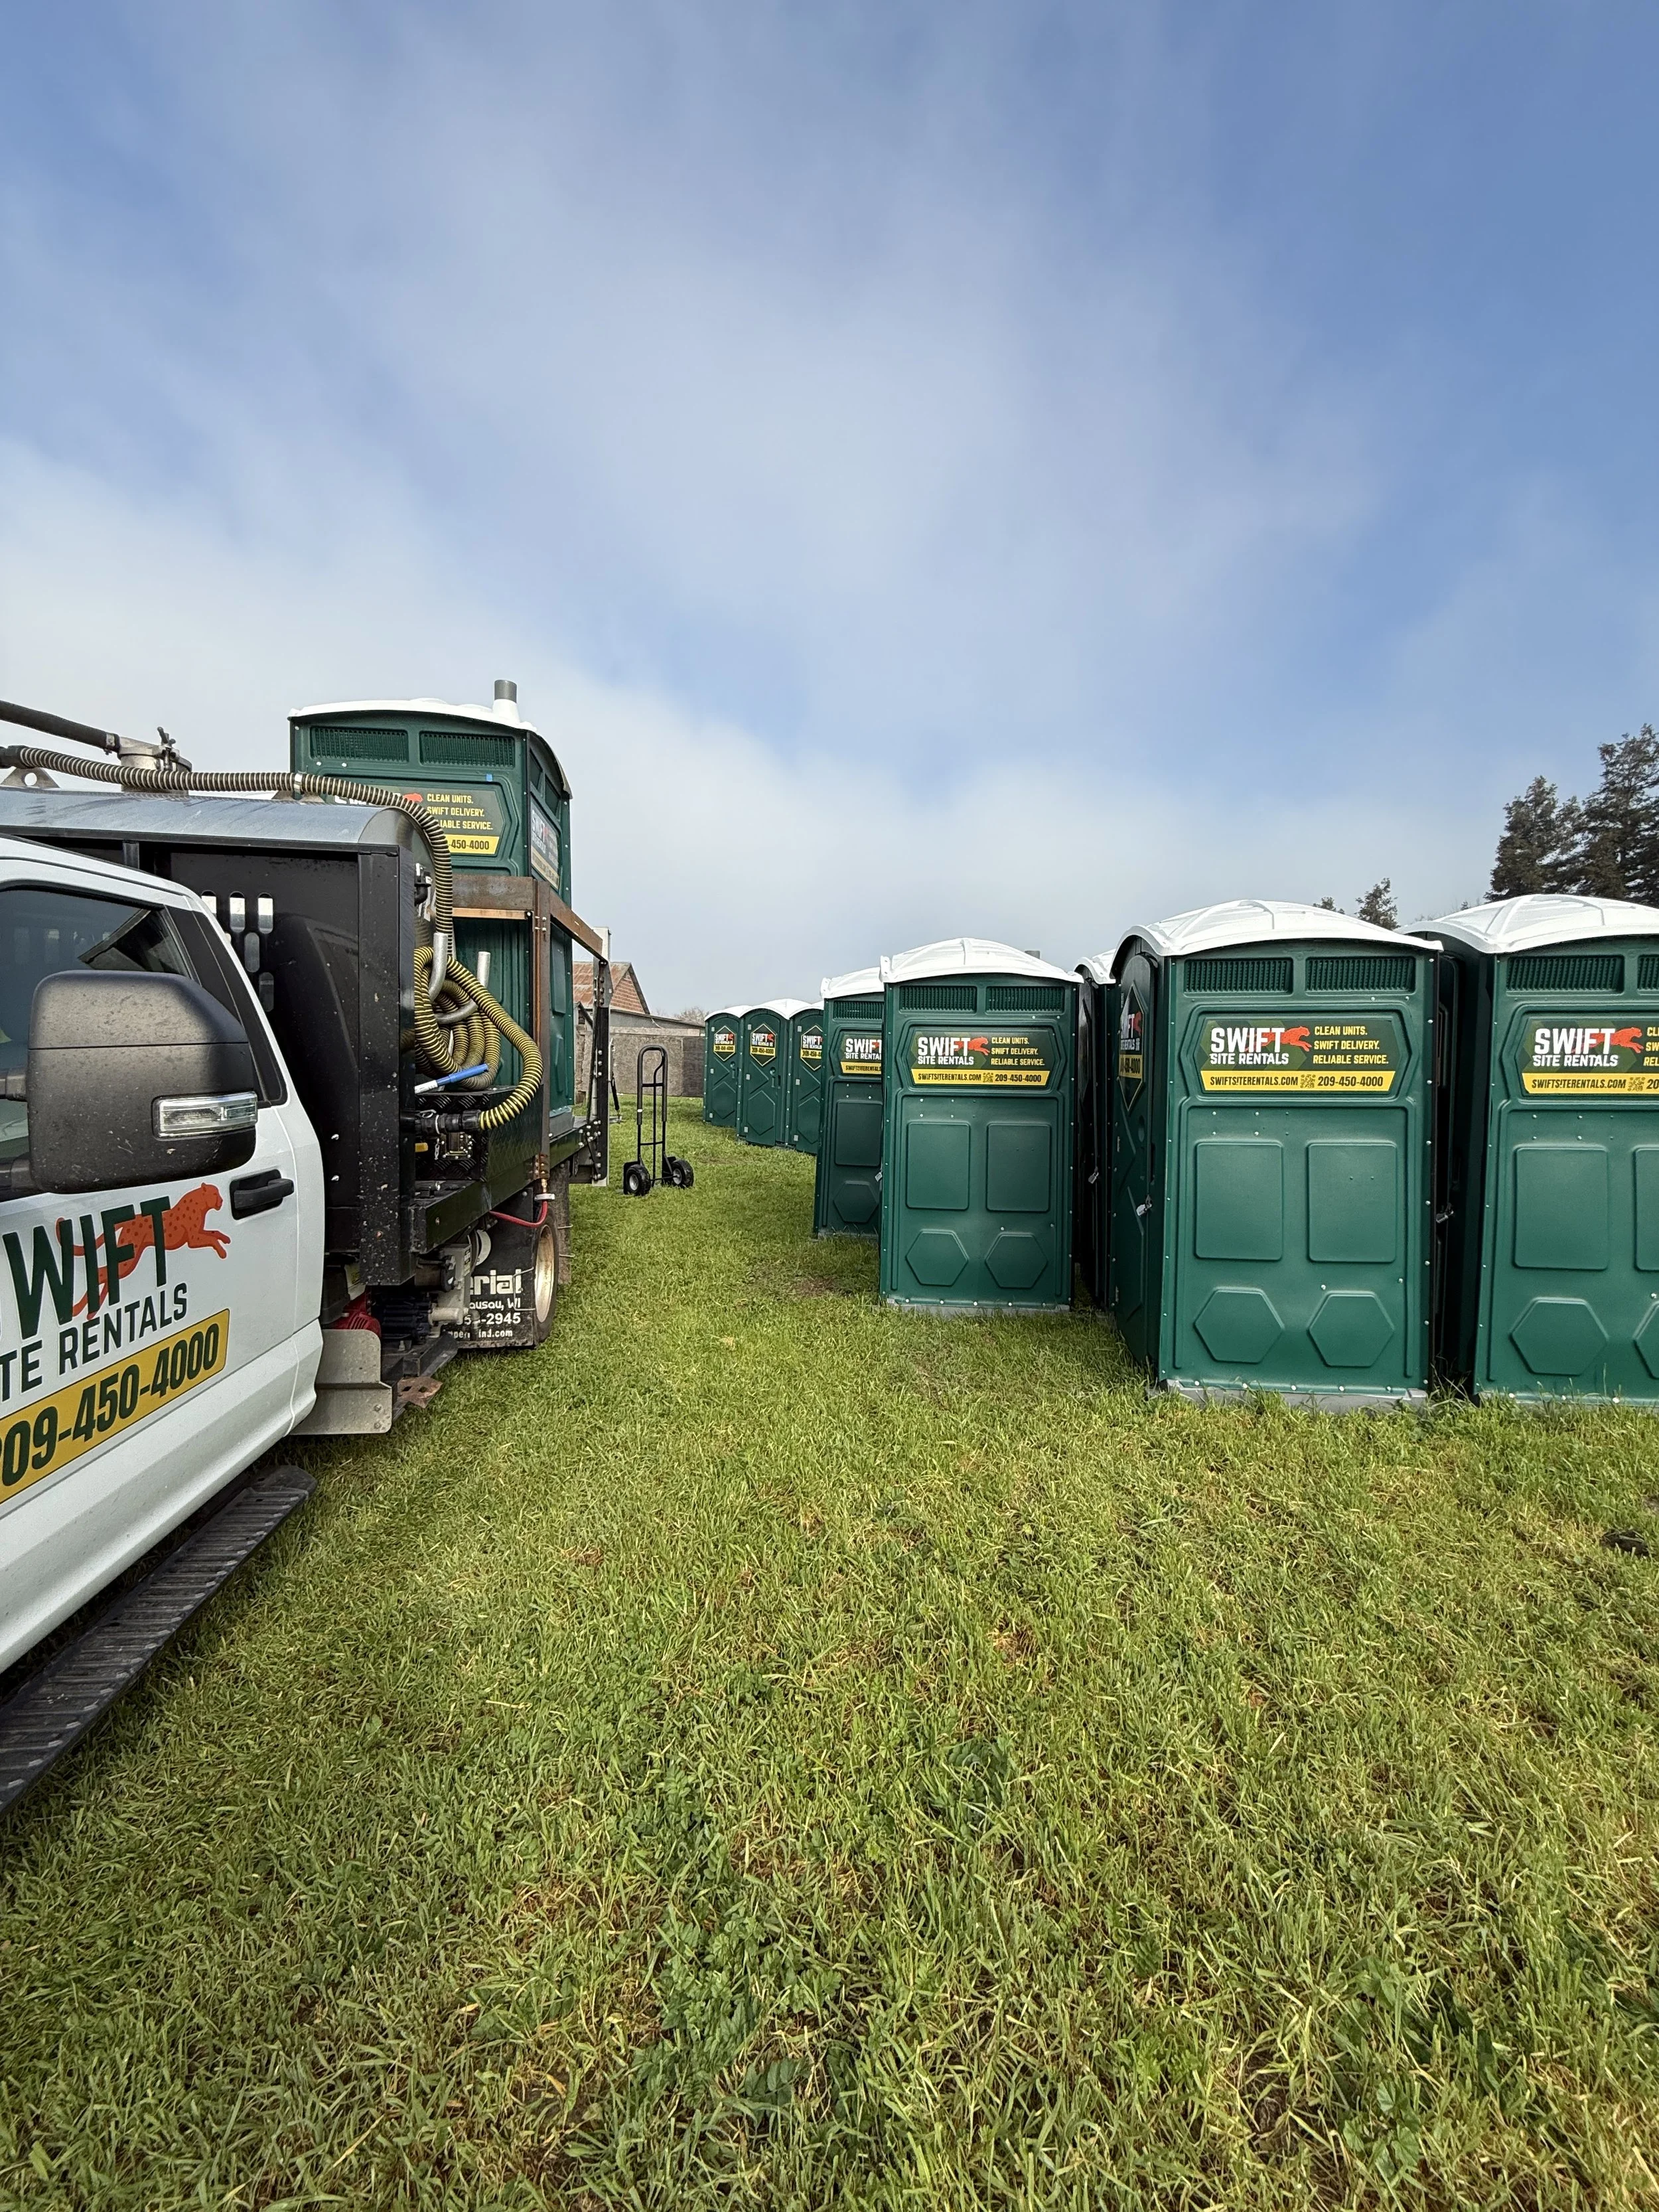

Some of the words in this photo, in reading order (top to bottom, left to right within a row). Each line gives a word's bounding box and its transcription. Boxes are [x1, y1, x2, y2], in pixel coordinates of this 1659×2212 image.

[427, 794, 451, 804] CLEAN
[452, 795, 474, 804] UNITS.
[427, 806, 450, 816] SWIFT
[451, 807, 485, 817] DELIVERY.
[435, 820, 461, 829] IABLE
[462, 820, 494, 830] SERVICE.
[449, 840, 490, 850] -450-4000
[1315, 1026, 1342, 1035] CLEAN
[1342, 1026, 1368, 1035] UNITS.
[752, 1033, 768, 1043] SWIFT
[803, 1035, 821, 1045] SWIFT
[1210, 1027, 1285, 1053] SWIFT
[1534, 1028, 1615, 1055] SWIFT
[845, 1038, 882, 1053] SWIFT
[918, 1037, 971, 1057] SWIFT
[1314, 1041, 1339, 1050] SWIFT
[1340, 1041, 1380, 1050] DELIVERY.
[1645, 1041, 1659, 1051] SW
[917, 1056, 936, 1065] SITE
[938, 1056, 974, 1065] RENTALS
[1210, 1053, 1235, 1065] SITE
[1238, 1053, 1289, 1065] RENTALS
[1313, 1055, 1352, 1064] RELIABLE
[1353, 1055, 1389, 1065] SERVICE.
[1533, 1055, 1561, 1067] SITE
[1563, 1055, 1619, 1067] RENTALS
[1643, 1057, 1659, 1067] REL
[918, 1072, 981, 1081] SWIFTSITERENTALS.COM
[995, 1074, 1042, 1082] 209-450-4000
[1210, 1076, 1298, 1086] SWIFTSITERENTALS.COM
[1317, 1076, 1384, 1086] 209-450-4000
[1532, 1079, 1626, 1089] SWIFTSITERENTALS.COM
[1646, 1079, 1659, 1090] 20
[0, 1196, 170, 1340] WIFT
[469, 1300, 504, 1311] ausau,
[507, 1297, 521, 1309] WI
[457, 1312, 521, 1325] 5-2945
[0, 1340, 42, 1401] TE
[59, 1282, 187, 1376] RENTALS
[0, 1323, 219, 1487] 09-450-4000
